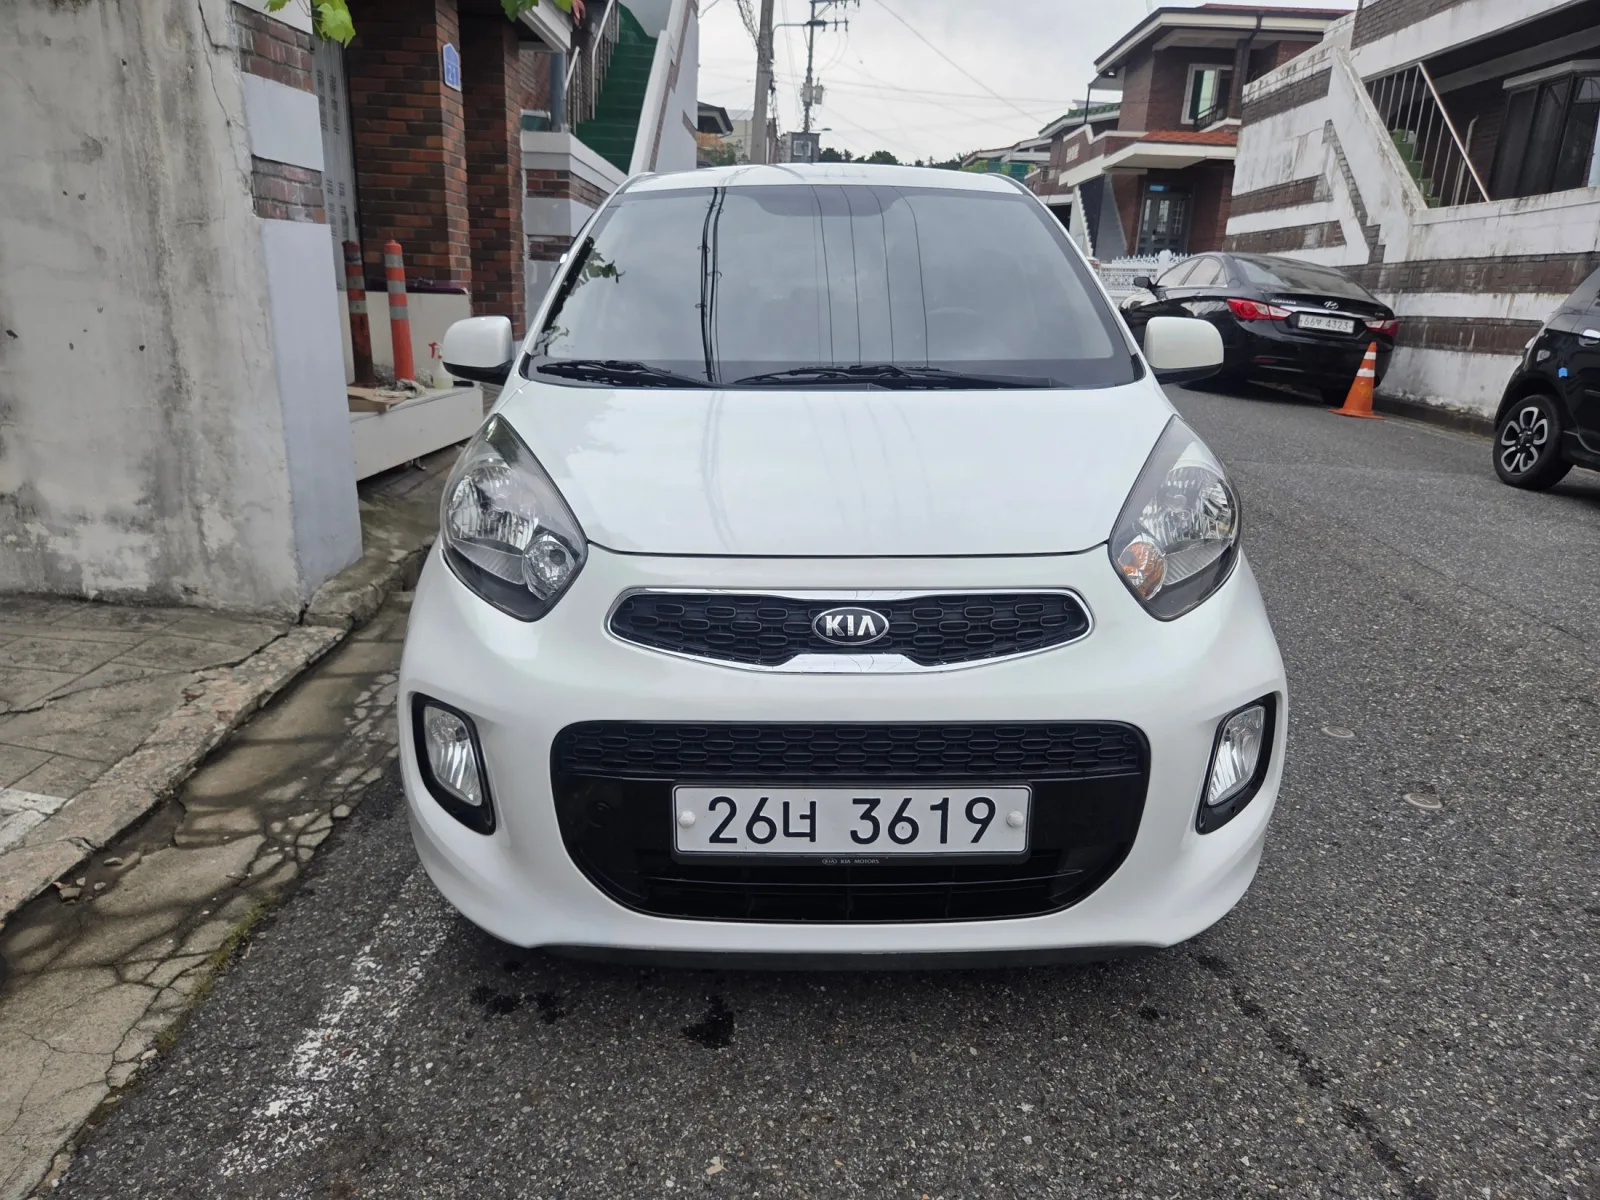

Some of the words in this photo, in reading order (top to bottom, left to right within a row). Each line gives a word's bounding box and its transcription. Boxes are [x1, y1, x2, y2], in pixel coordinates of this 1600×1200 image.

[1325, 319, 1349, 331] 4323
[824, 614, 878, 637] KIA
[708, 796, 817, 844] 26너
[849, 797, 997, 845] 3619
